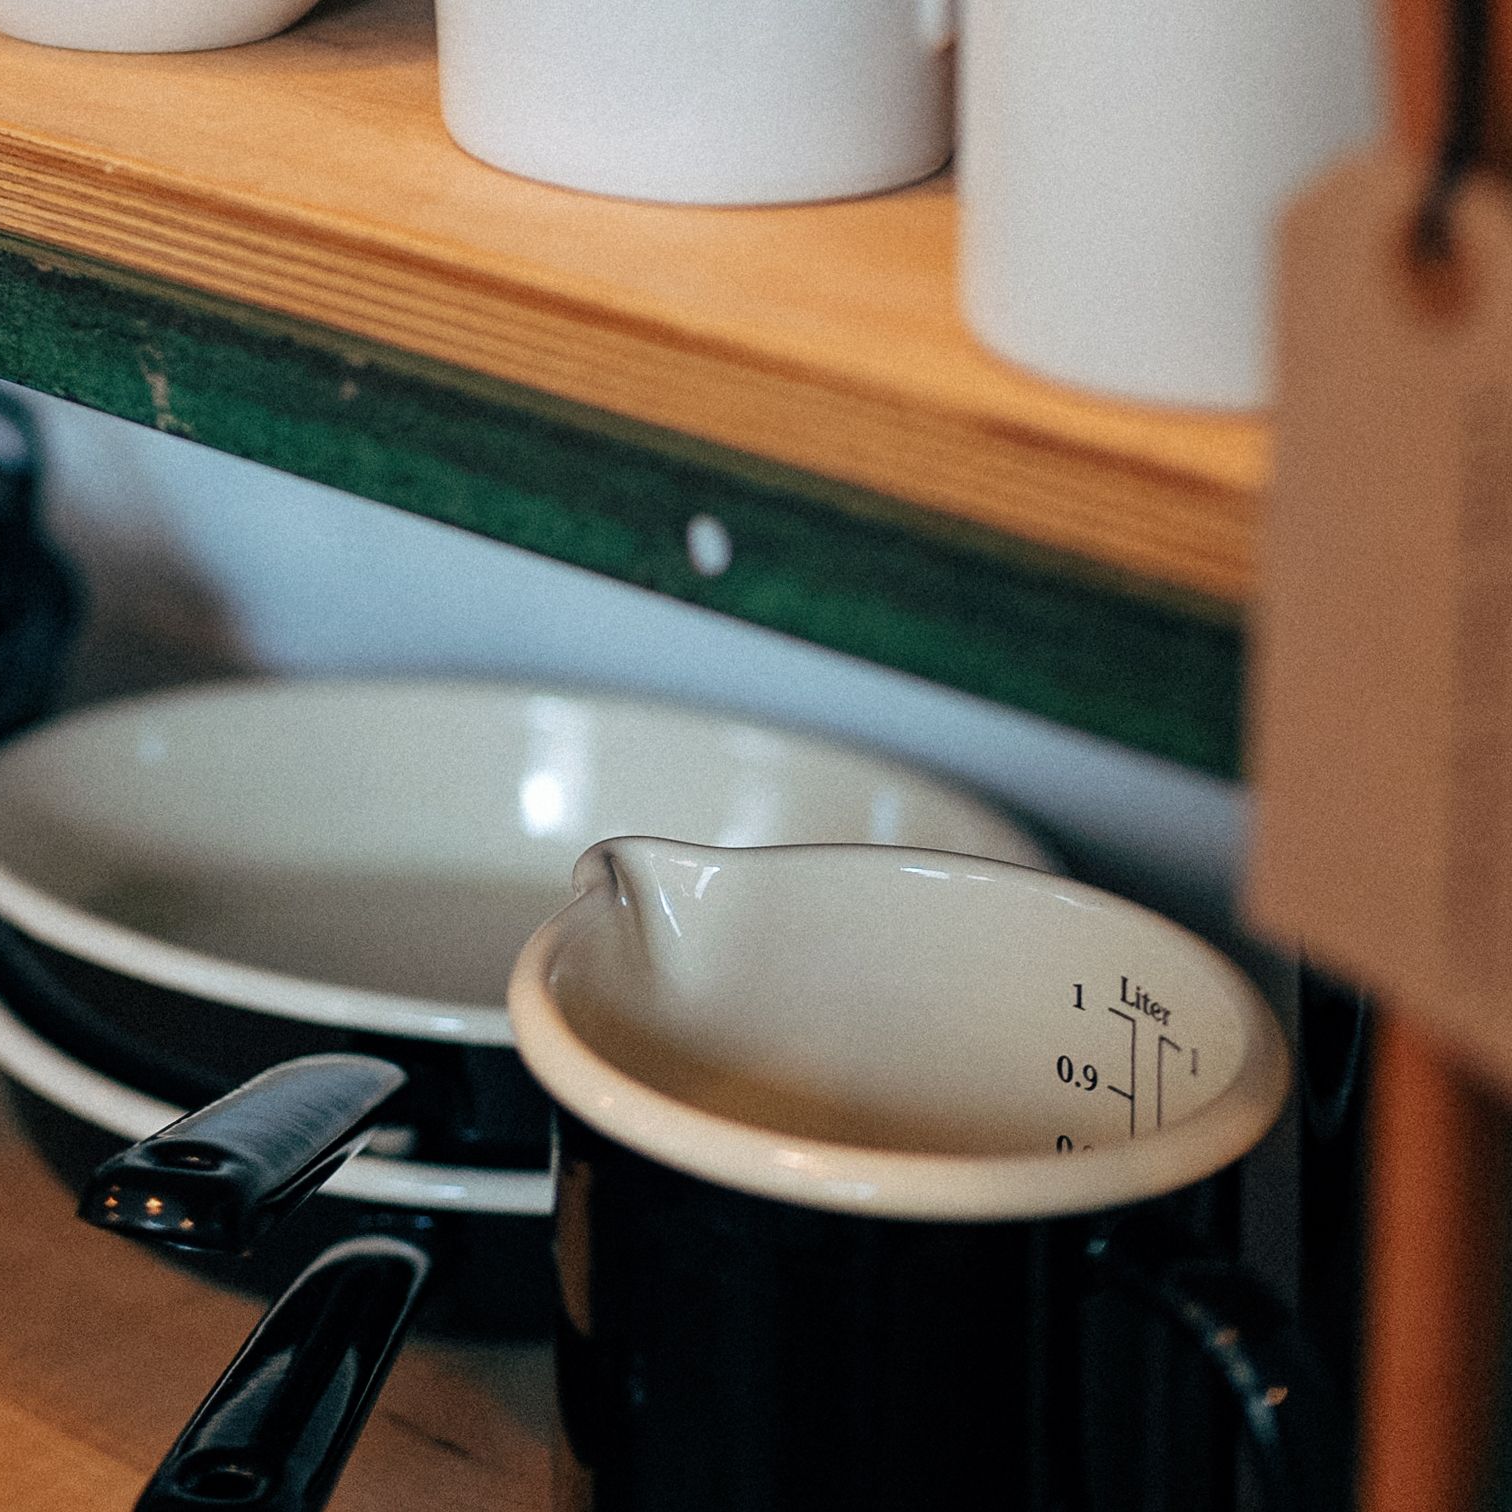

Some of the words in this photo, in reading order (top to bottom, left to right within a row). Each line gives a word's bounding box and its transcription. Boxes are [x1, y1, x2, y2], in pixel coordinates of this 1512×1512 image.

[1073, 983, 1086, 1010] 1
[1120, 976, 1171, 1026] Liter
[1056, 1054, 1098, 1091] 0.9
